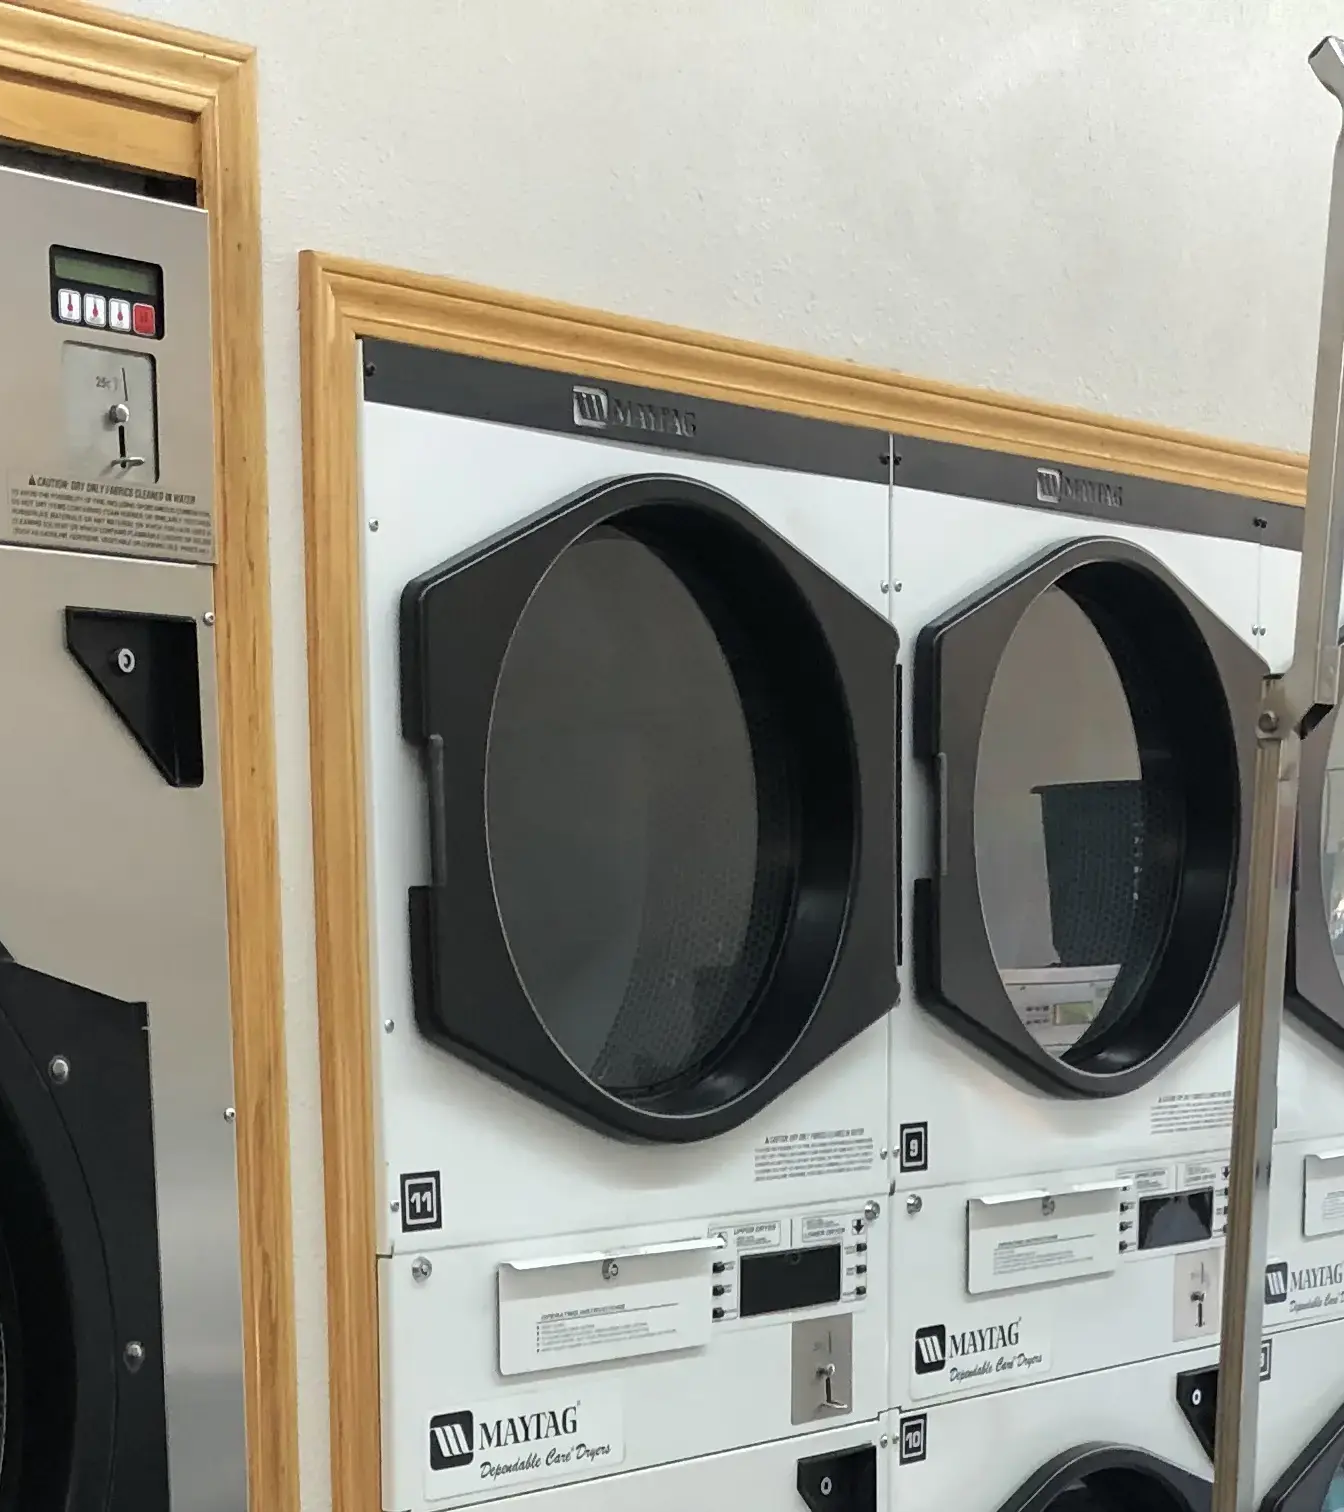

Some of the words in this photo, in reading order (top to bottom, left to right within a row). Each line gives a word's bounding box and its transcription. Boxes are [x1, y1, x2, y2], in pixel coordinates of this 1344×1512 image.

[612, 399, 697, 437] MAYTAG
[910, 1139, 918, 1157] 9
[410, 1191, 432, 1213] 11
[1290, 1263, 1343, 1292] MAYTAG
[948, 1321, 1020, 1358] MAYTAG
[949, 1361, 993, 1383] Dependable
[479, 1406, 578, 1450] MAYTAG
[906, 1430, 921, 1449] 10
[480, 1453, 541, 1480] Dependable
[576, 1443, 611, 1462] Dryers
